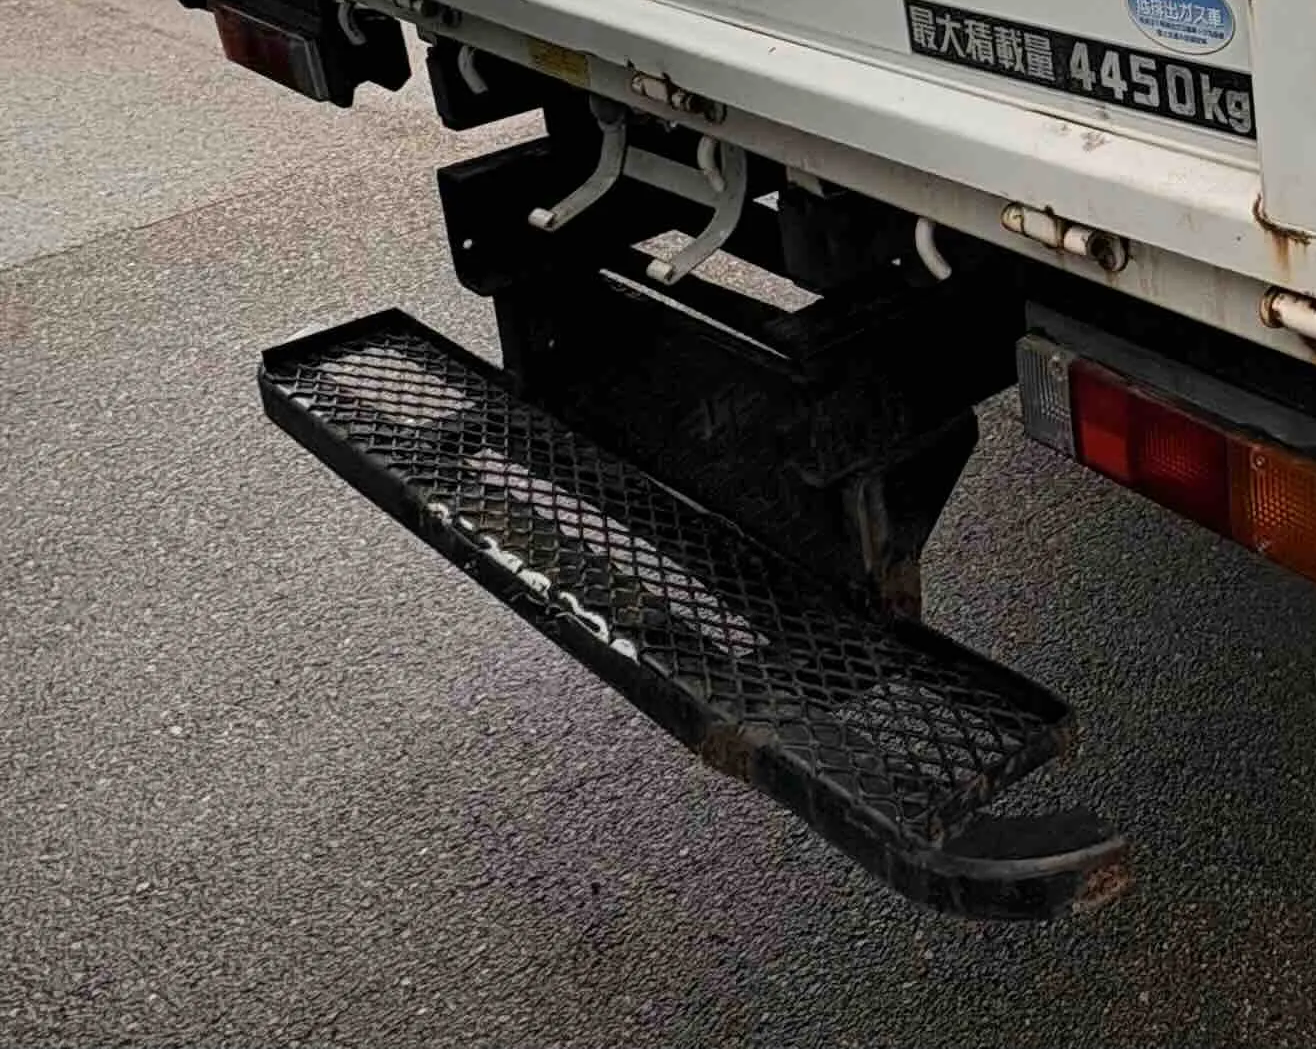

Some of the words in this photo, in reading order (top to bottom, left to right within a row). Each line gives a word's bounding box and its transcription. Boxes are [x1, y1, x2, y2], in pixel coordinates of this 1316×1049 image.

[910, 5, 1056, 81] 最大積載量
[1069, 42, 1252, 134] 4450kg
